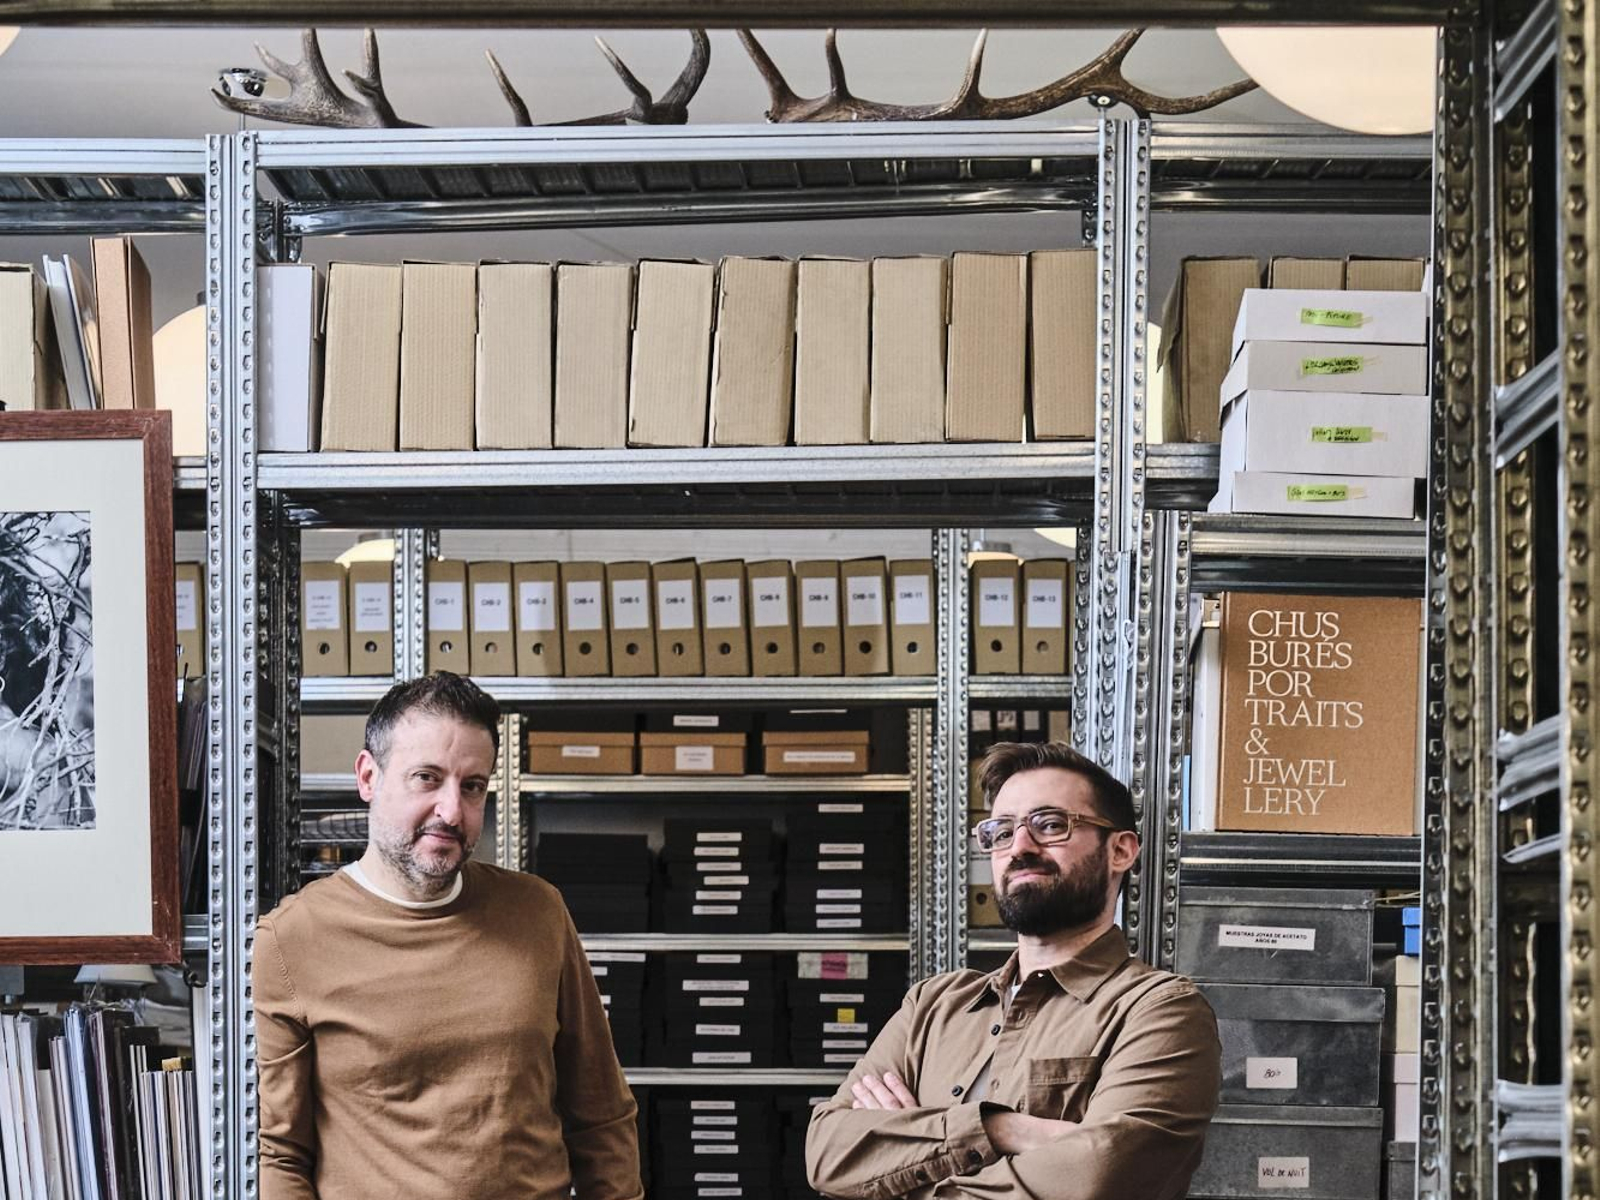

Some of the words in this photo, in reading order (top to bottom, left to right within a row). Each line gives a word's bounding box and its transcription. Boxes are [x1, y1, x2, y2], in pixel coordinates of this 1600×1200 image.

[1248, 609, 1340, 639] CHUS
[1247, 637, 1353, 670] BURÉS
[1247, 669, 1315, 698] POR
[1244, 699, 1364, 729] TRAITS
[1244, 728, 1270, 755] &
[1242, 758, 1347, 787] JEWEL
[1243, 787, 1326, 816] LERY
